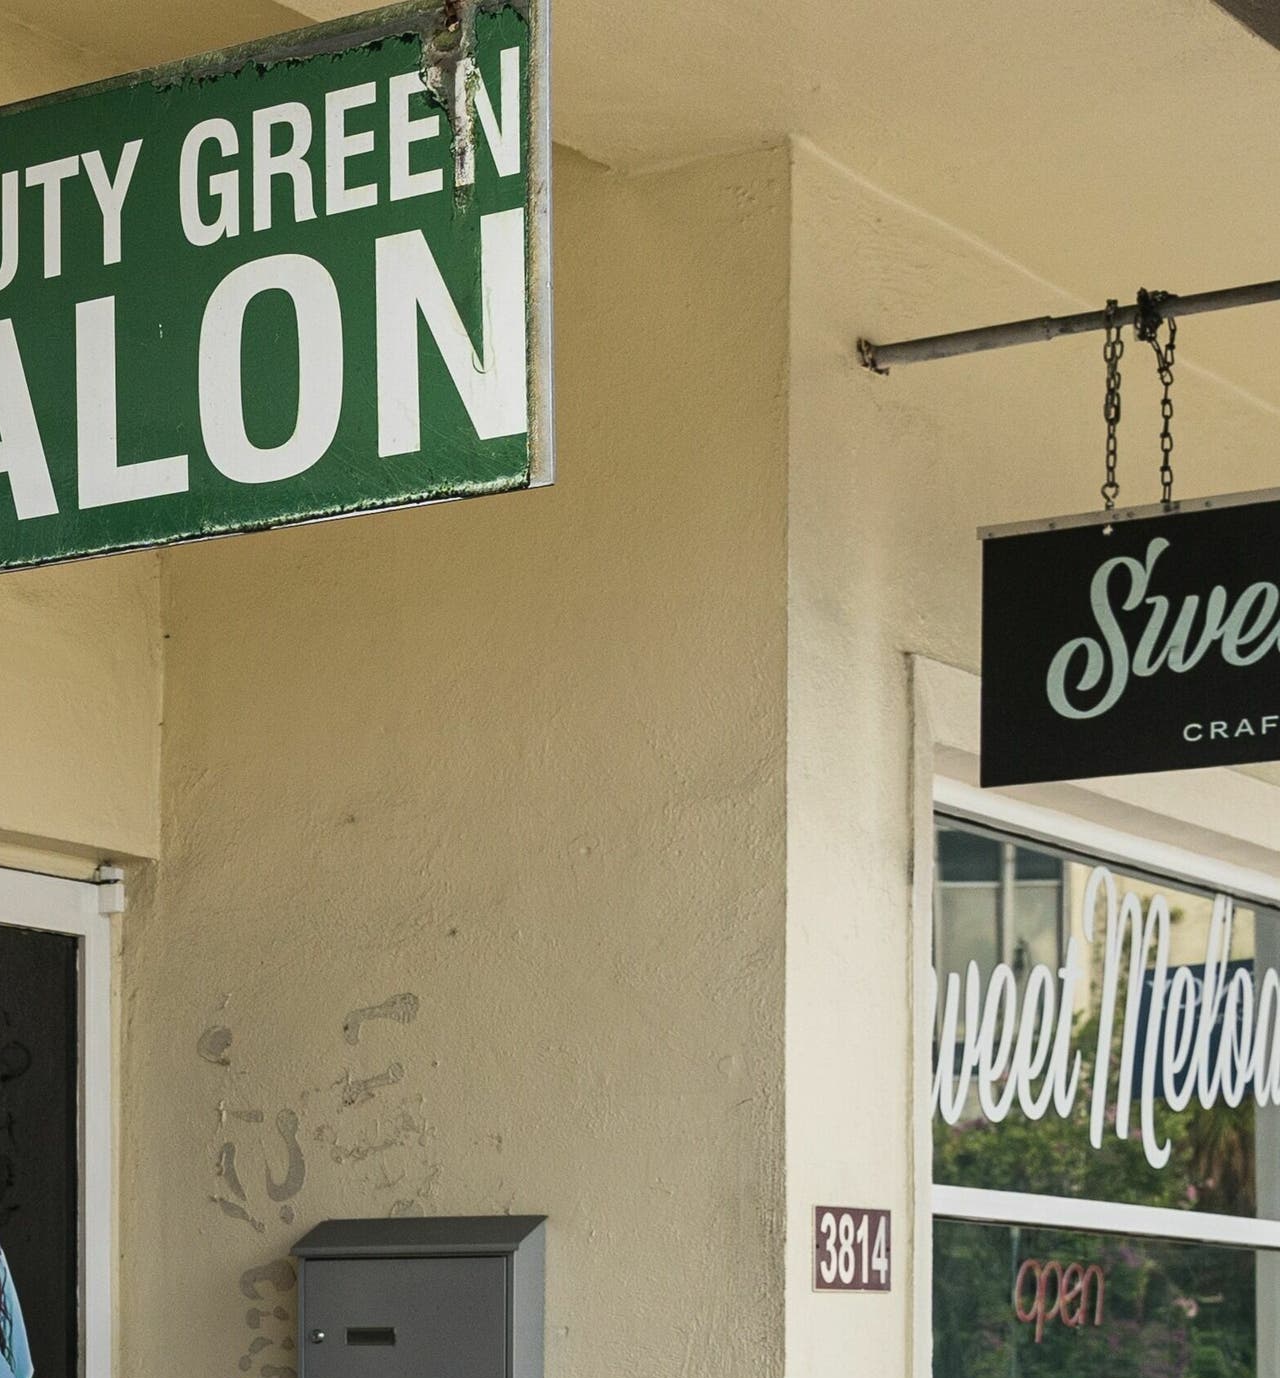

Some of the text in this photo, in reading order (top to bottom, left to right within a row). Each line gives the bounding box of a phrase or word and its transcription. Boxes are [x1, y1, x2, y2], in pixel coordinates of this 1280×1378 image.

[178, 46, 521, 247] GREEN
[1046, 537, 1280, 719] Swe
[1183, 715, 1279, 741] CRAF
[820, 1211, 888, 1286] 3814
[1014, 1257, 1105, 1343] open
